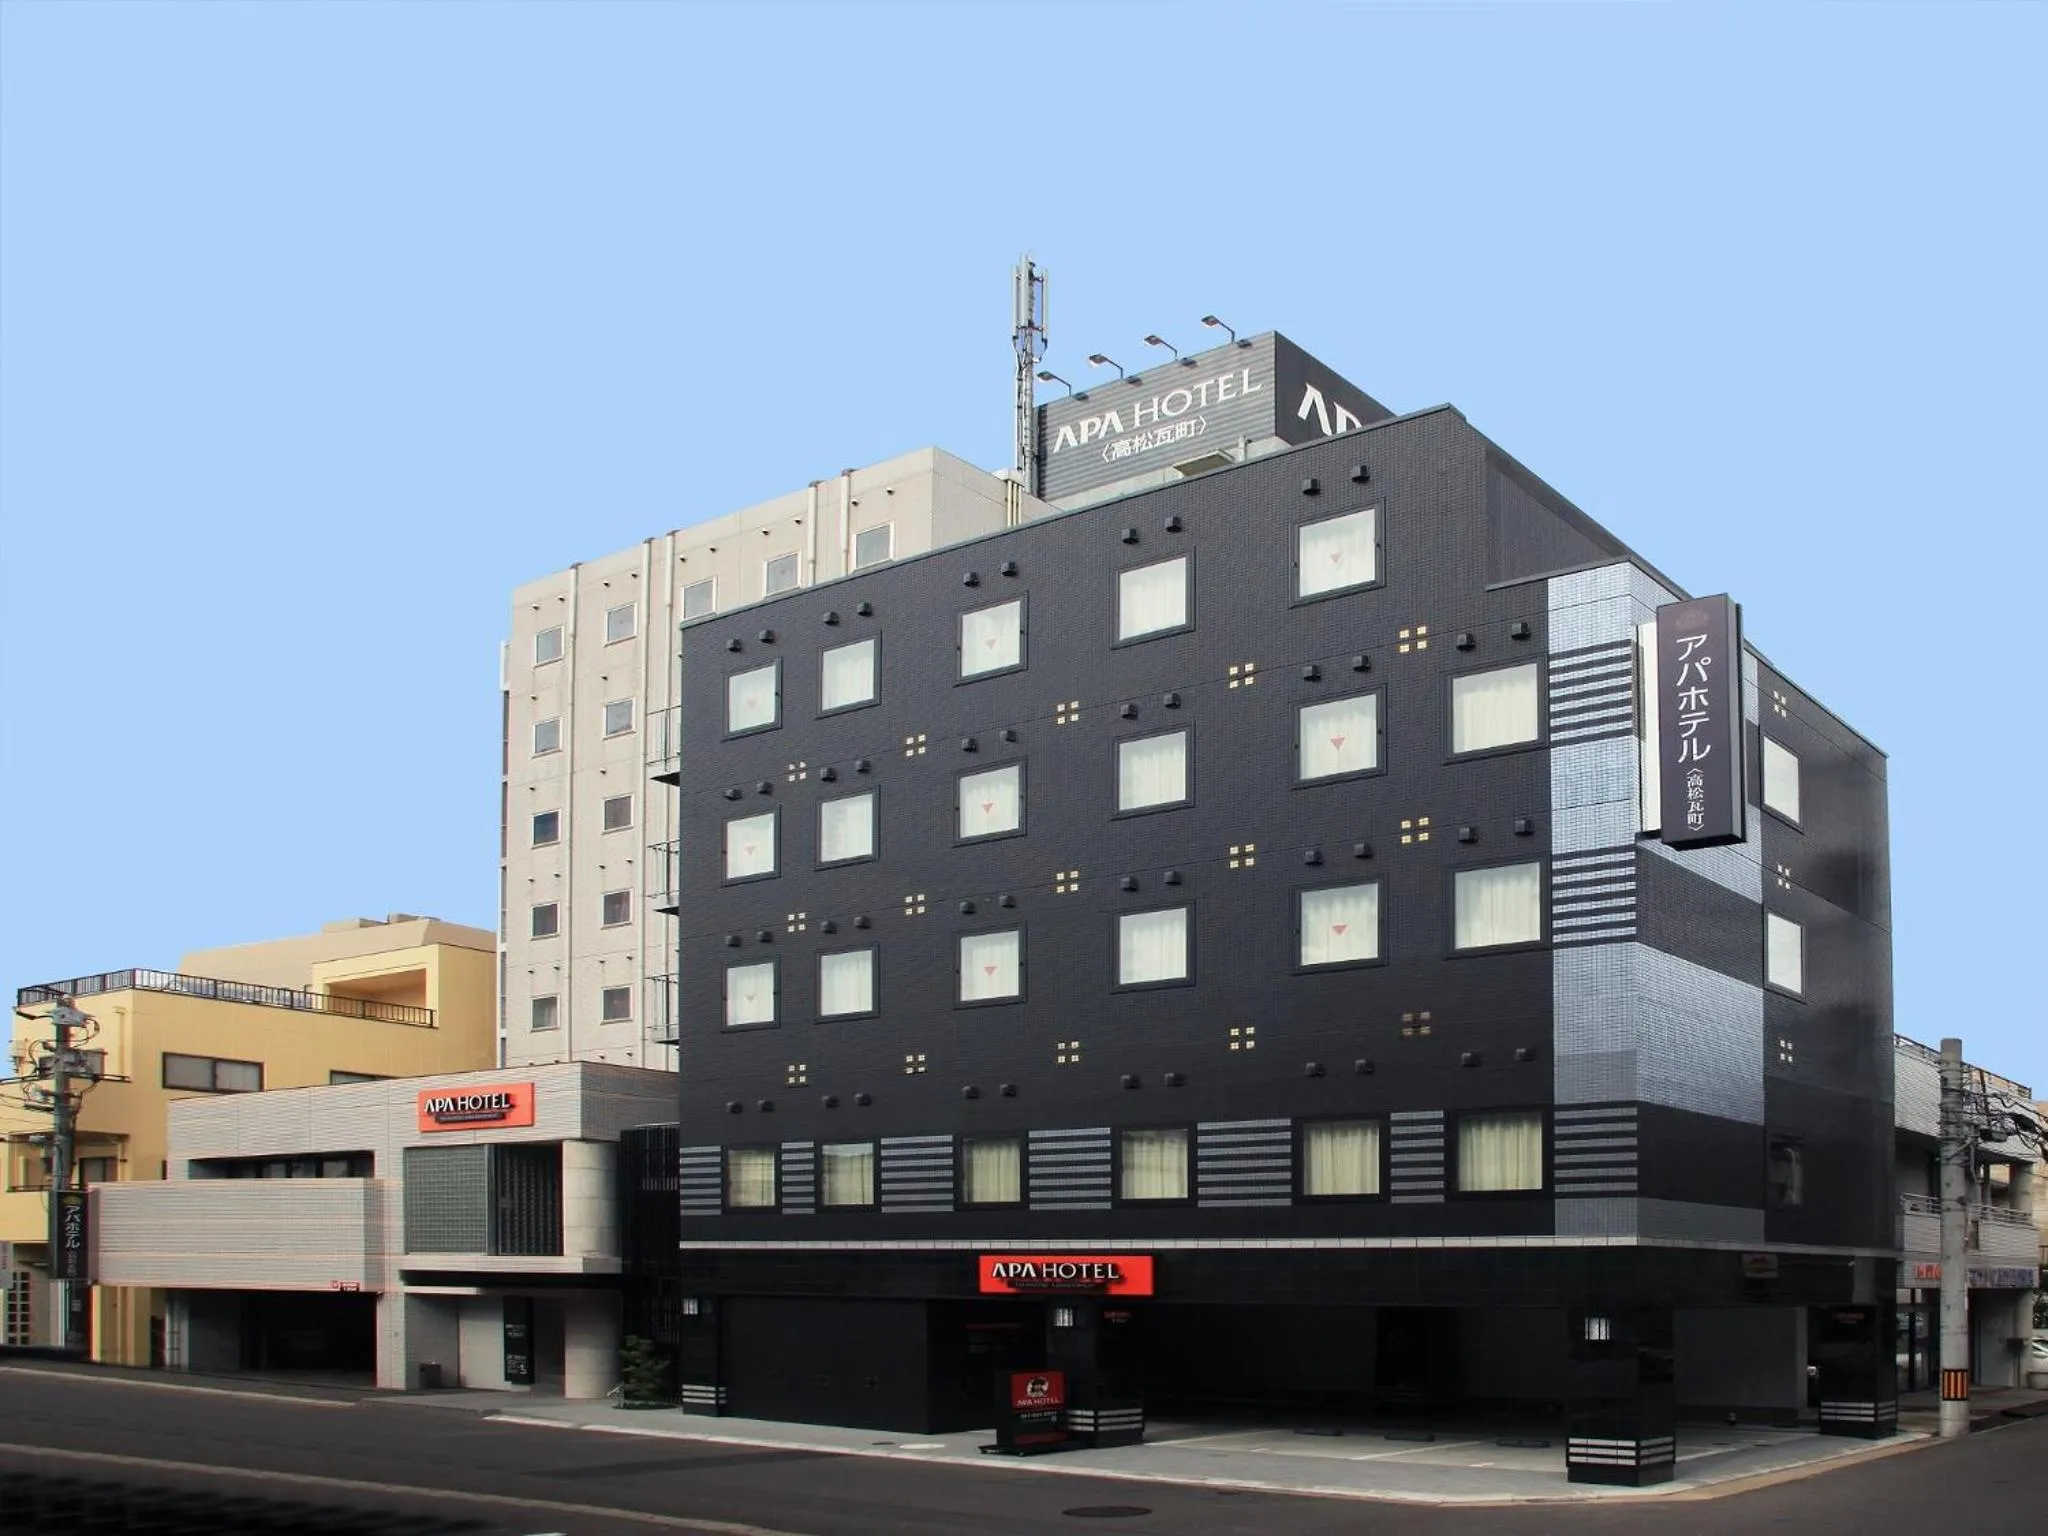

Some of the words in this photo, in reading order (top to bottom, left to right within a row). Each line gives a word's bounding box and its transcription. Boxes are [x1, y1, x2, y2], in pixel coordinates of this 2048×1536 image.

[1053, 410, 1124, 453] APA
[1134, 368, 1263, 428] HOTEL
[1676, 633, 1712, 763] アパホテル
[424, 1097, 454, 1113] APA
[457, 1092, 511, 1111] HOTEL
[992, 1262, 1037, 1278] APA
[1042, 1262, 1119, 1279] HOTEL
